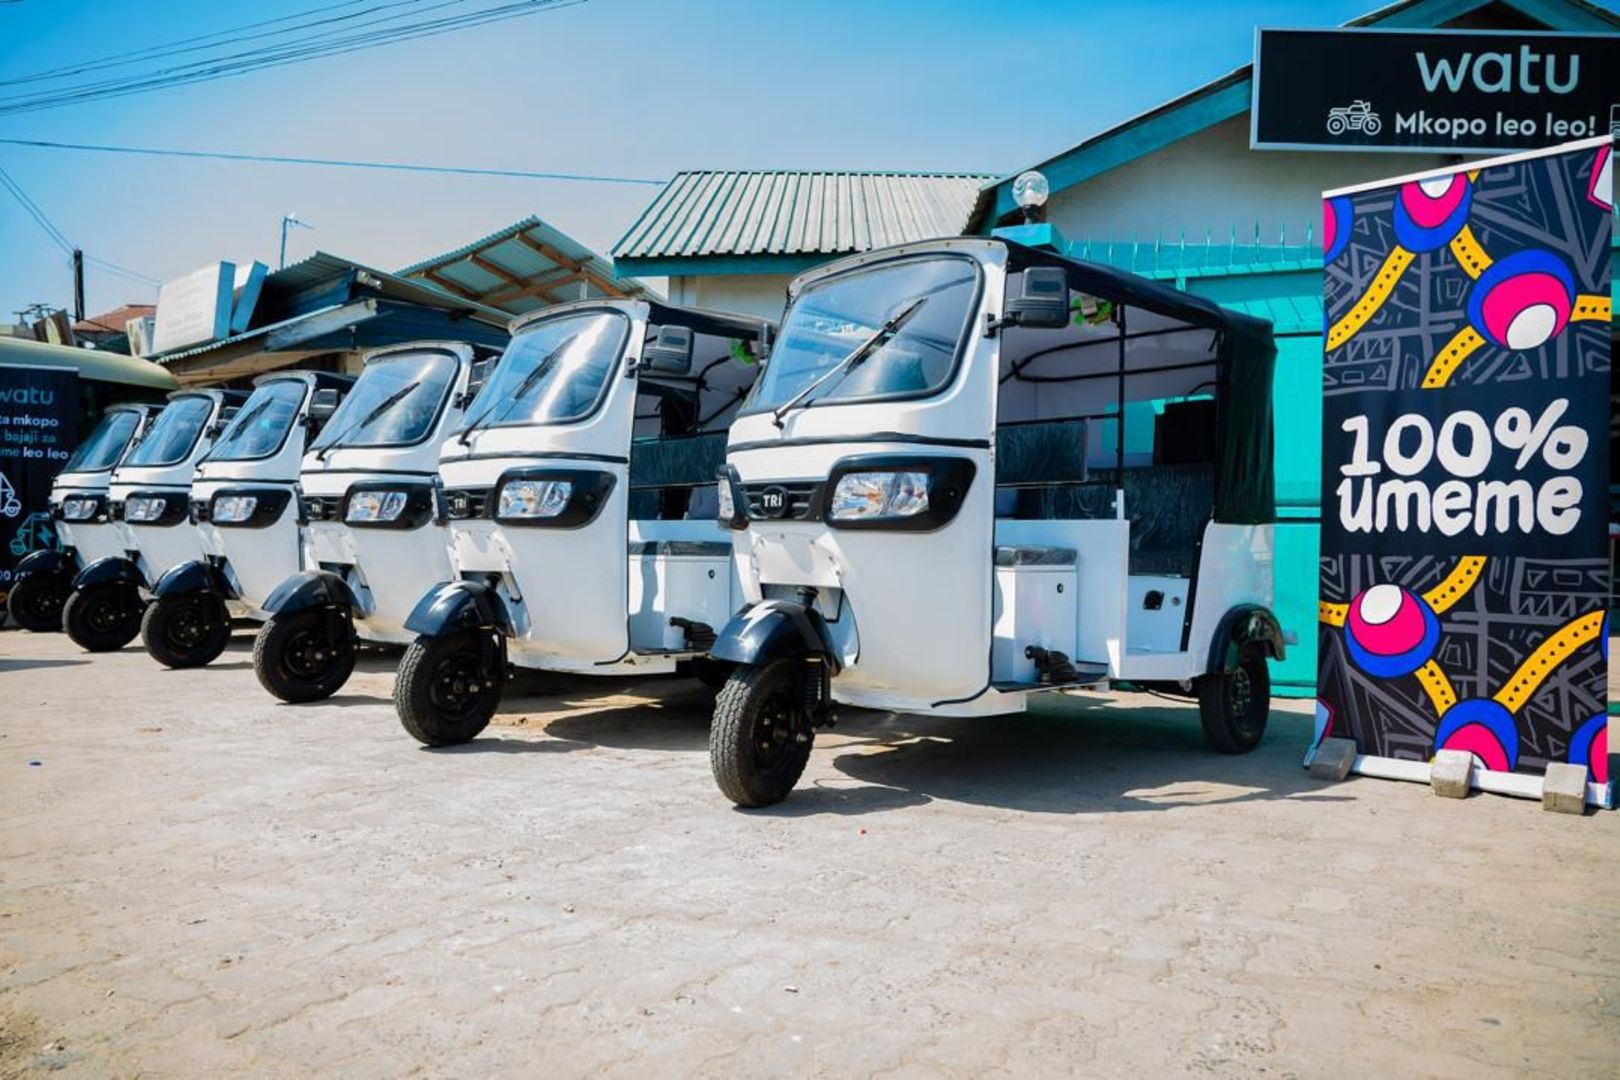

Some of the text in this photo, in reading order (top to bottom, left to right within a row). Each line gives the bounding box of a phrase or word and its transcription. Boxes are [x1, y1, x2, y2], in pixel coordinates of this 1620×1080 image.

[1415, 45, 1579, 94] watu
[1395, 111, 1596, 139] Mkopo leo leo!
[13, 413, 59, 429] mkopo
[1339, 398, 1589, 478] 100%
[23, 446, 44, 458] leo
[47, 447, 69, 460] leo
[1336, 476, 1584, 536] umeme
